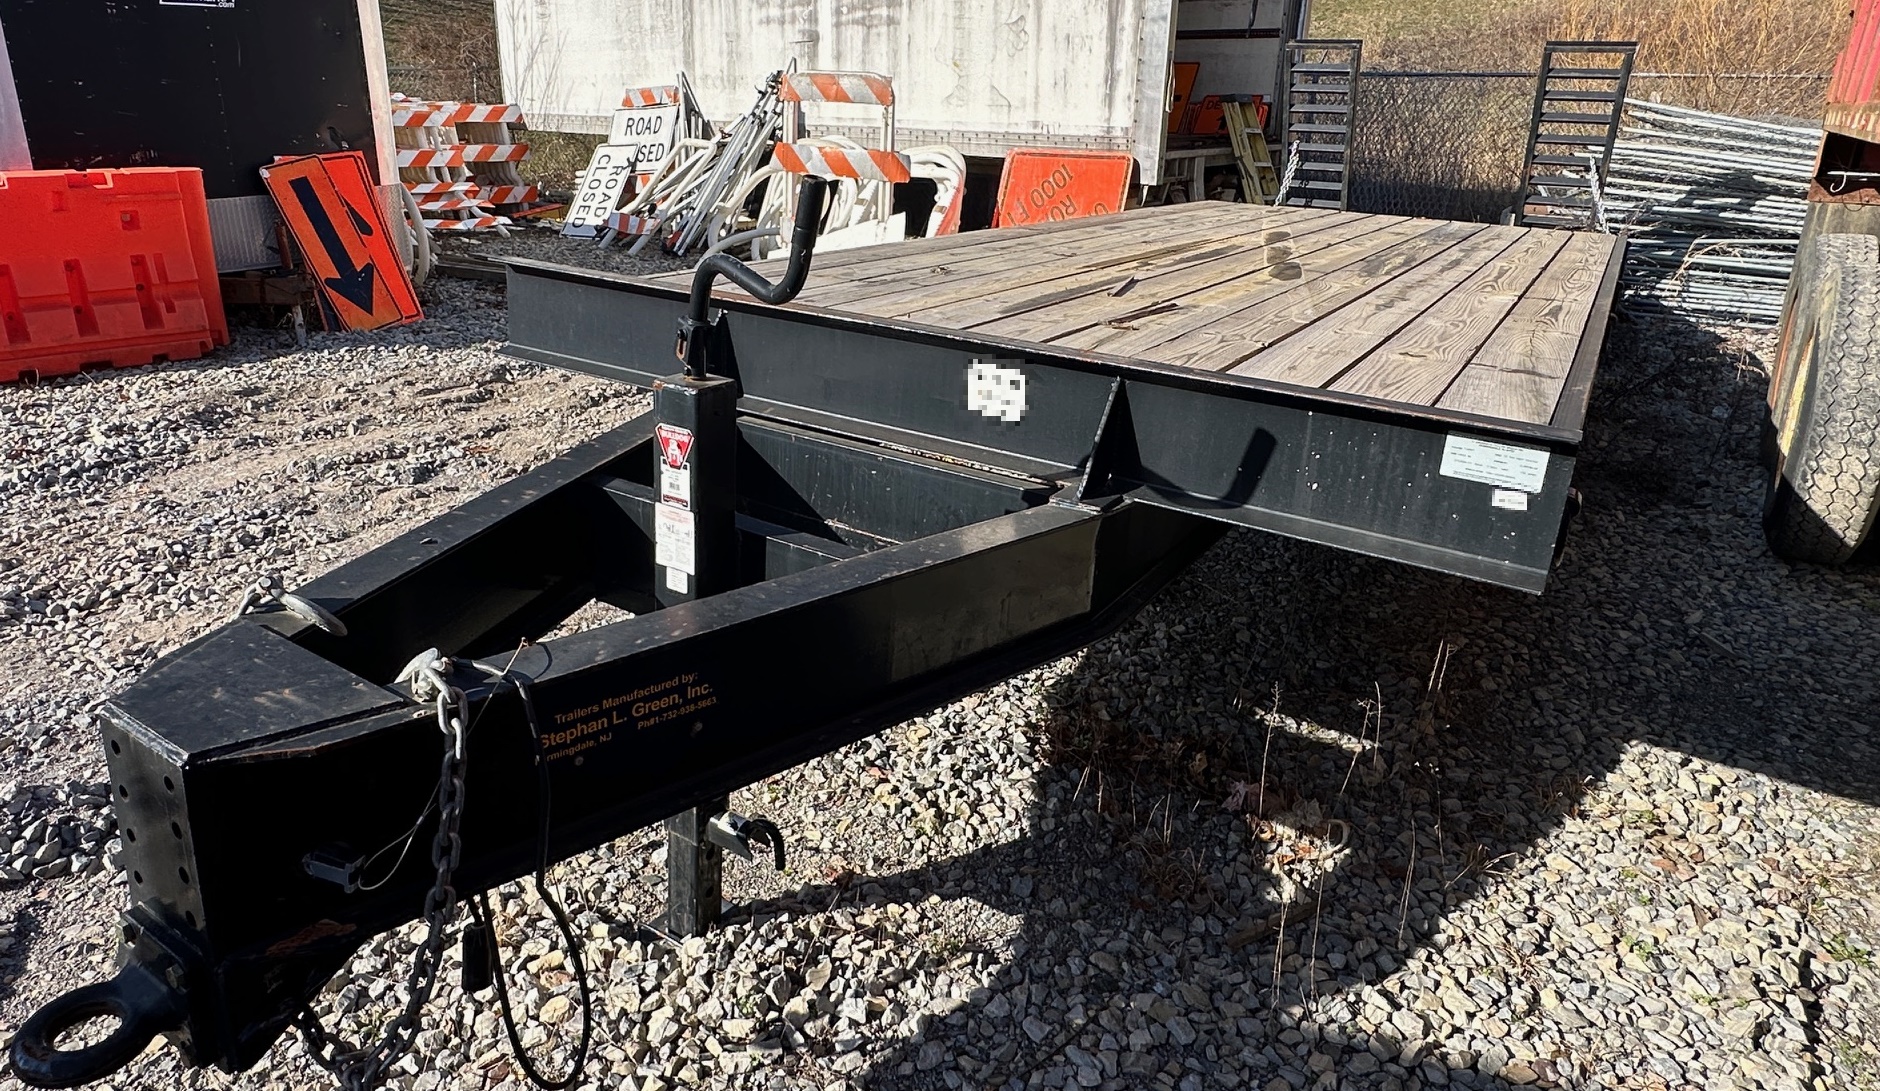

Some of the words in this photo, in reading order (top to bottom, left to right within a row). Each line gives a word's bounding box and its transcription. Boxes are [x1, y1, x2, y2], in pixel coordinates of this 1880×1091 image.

[624, 116, 663, 136] ROAD
[637, 143, 664, 163] SED
[571, 154, 611, 228] CLOSED
[593, 165, 623, 218] ROAD
[1030, 163, 1074, 209] 1000
[1044, 195, 1078, 222] RO
[540, 717, 608, 749] Stephan
[612, 711, 628, 725] L.
[631, 694, 683, 717] Green,
[687, 684, 713, 699] Inc.
[554, 704, 600, 724] Trailers
[602, 676, 679, 710] Manufactured
[681, 672, 699, 684] by:
[546, 740, 597, 762] rmingdale,
[599, 732, 612, 743] NJ
